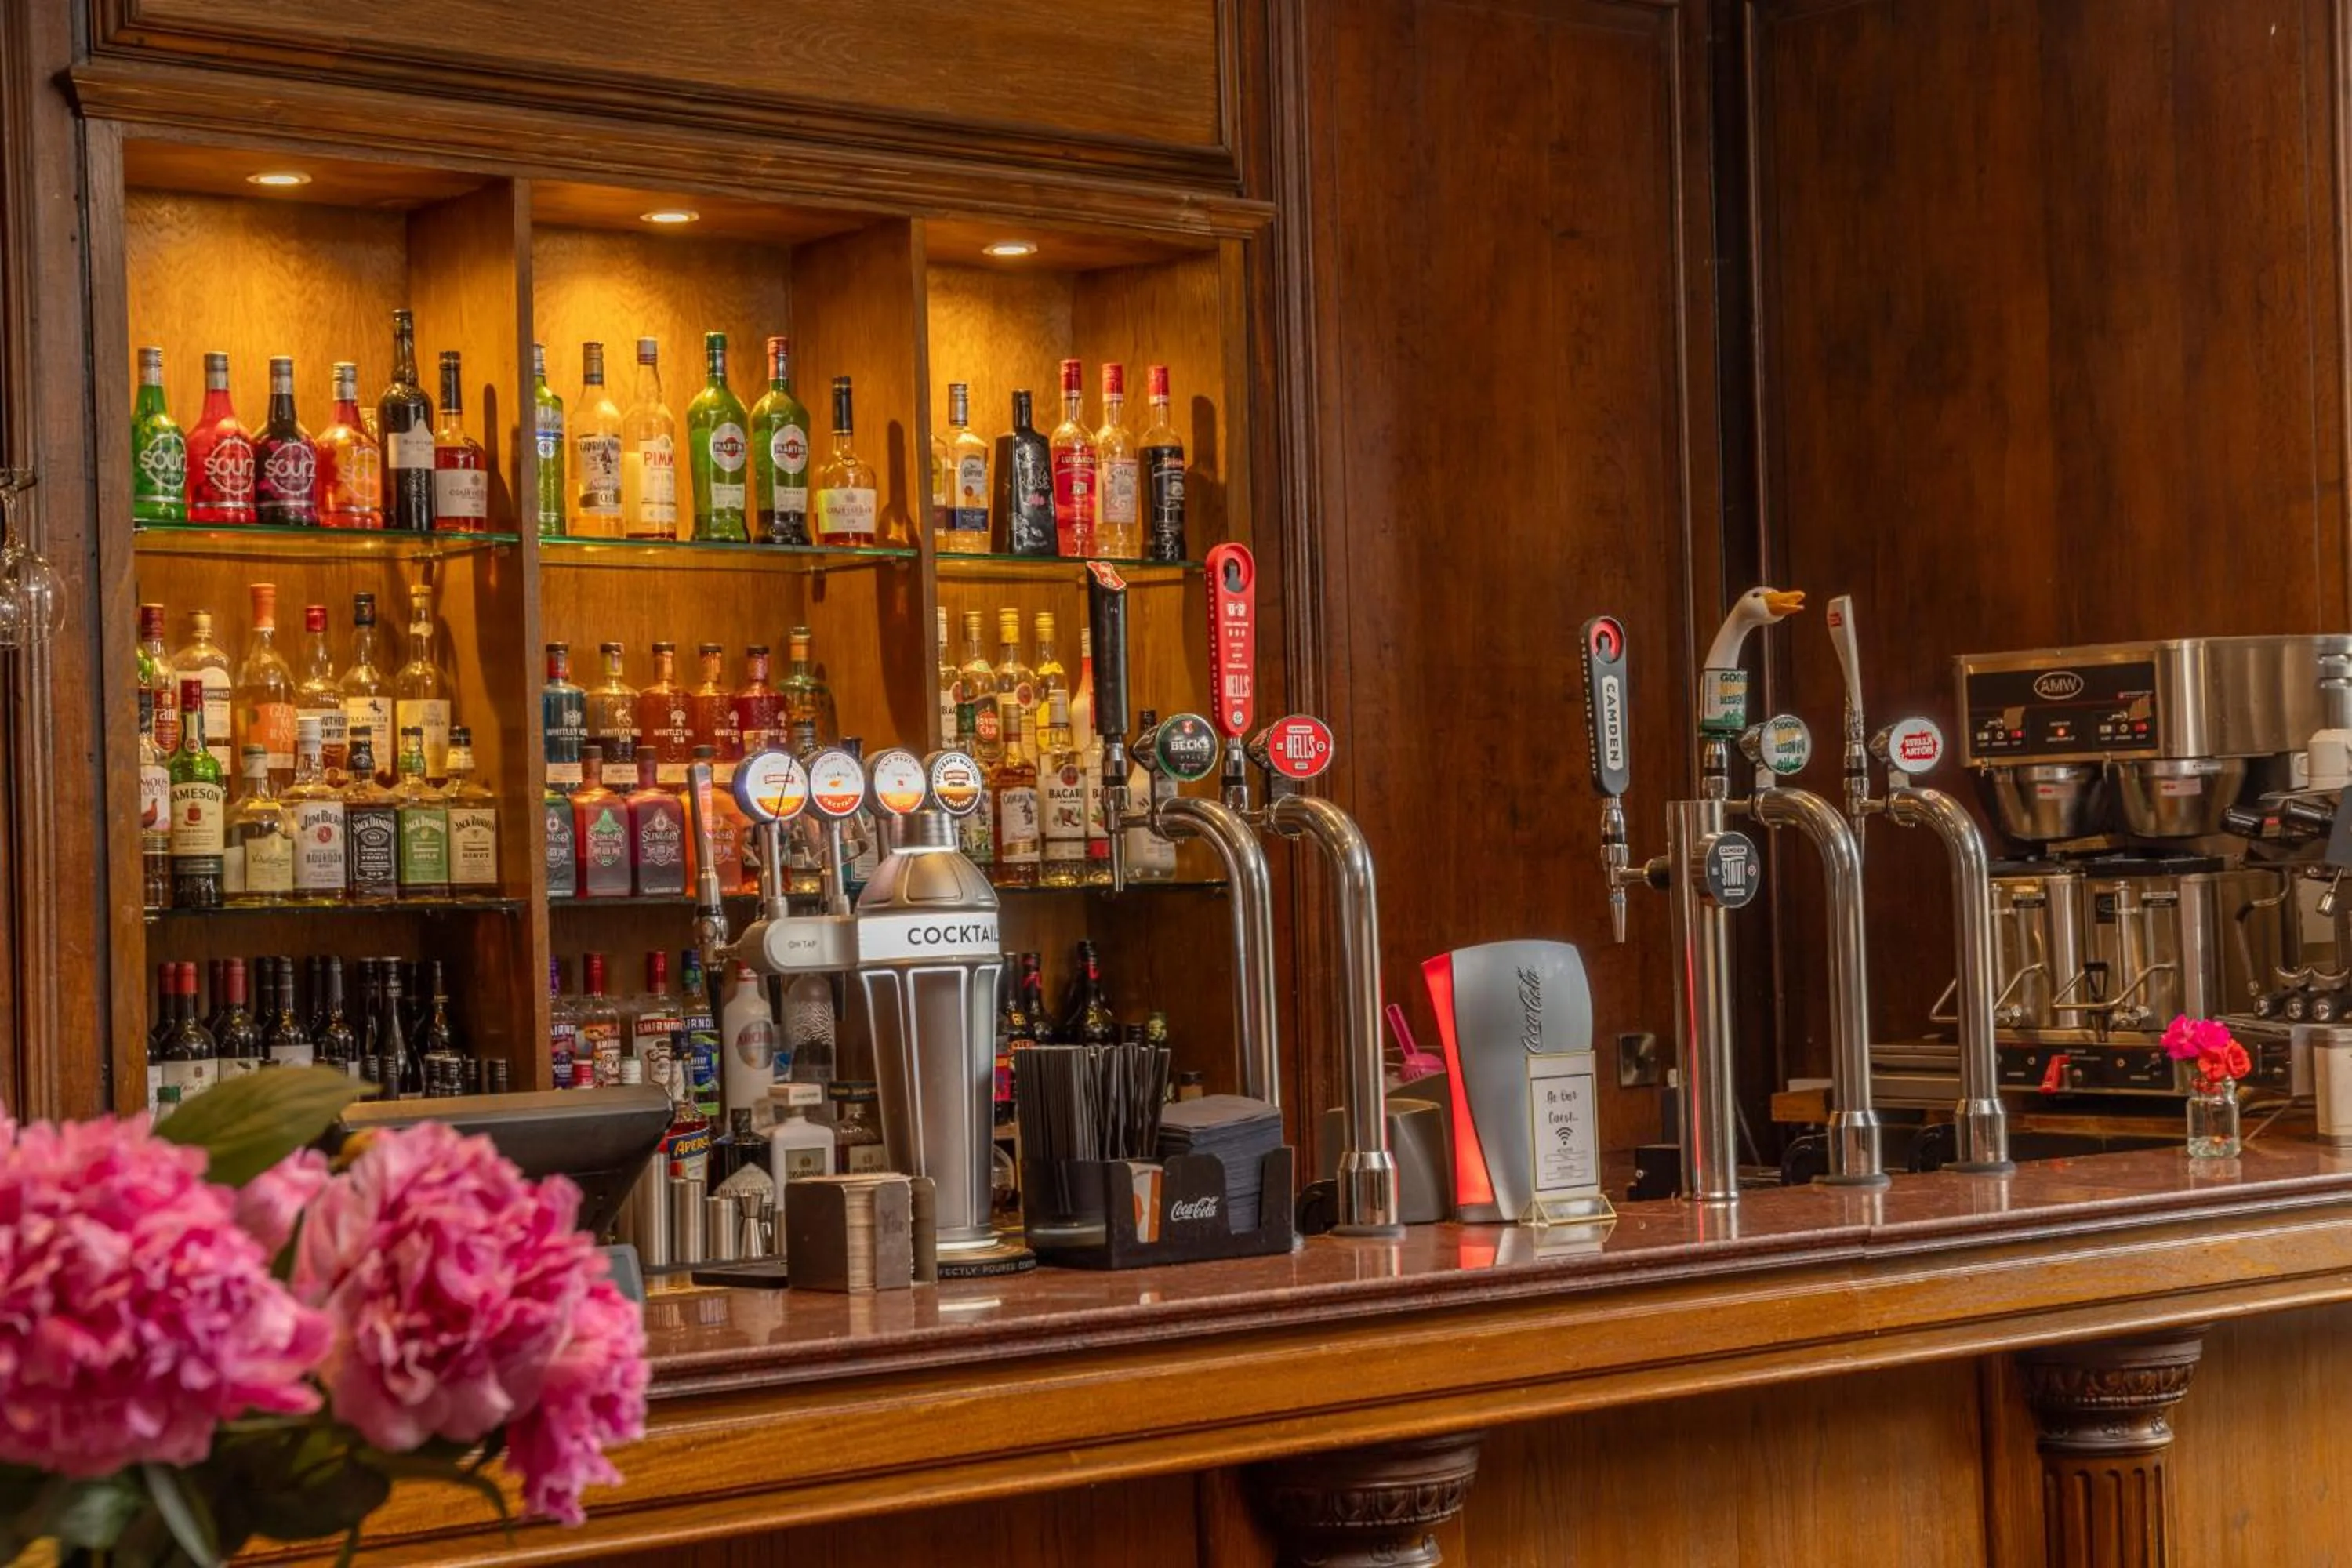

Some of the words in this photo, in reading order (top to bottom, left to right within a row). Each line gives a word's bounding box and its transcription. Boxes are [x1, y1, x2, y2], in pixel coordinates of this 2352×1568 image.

[2040, 677, 2079, 693] AMW
[1606, 683, 1620, 762] CAMDEN
[1286, 735, 1316, 759] HELLS
